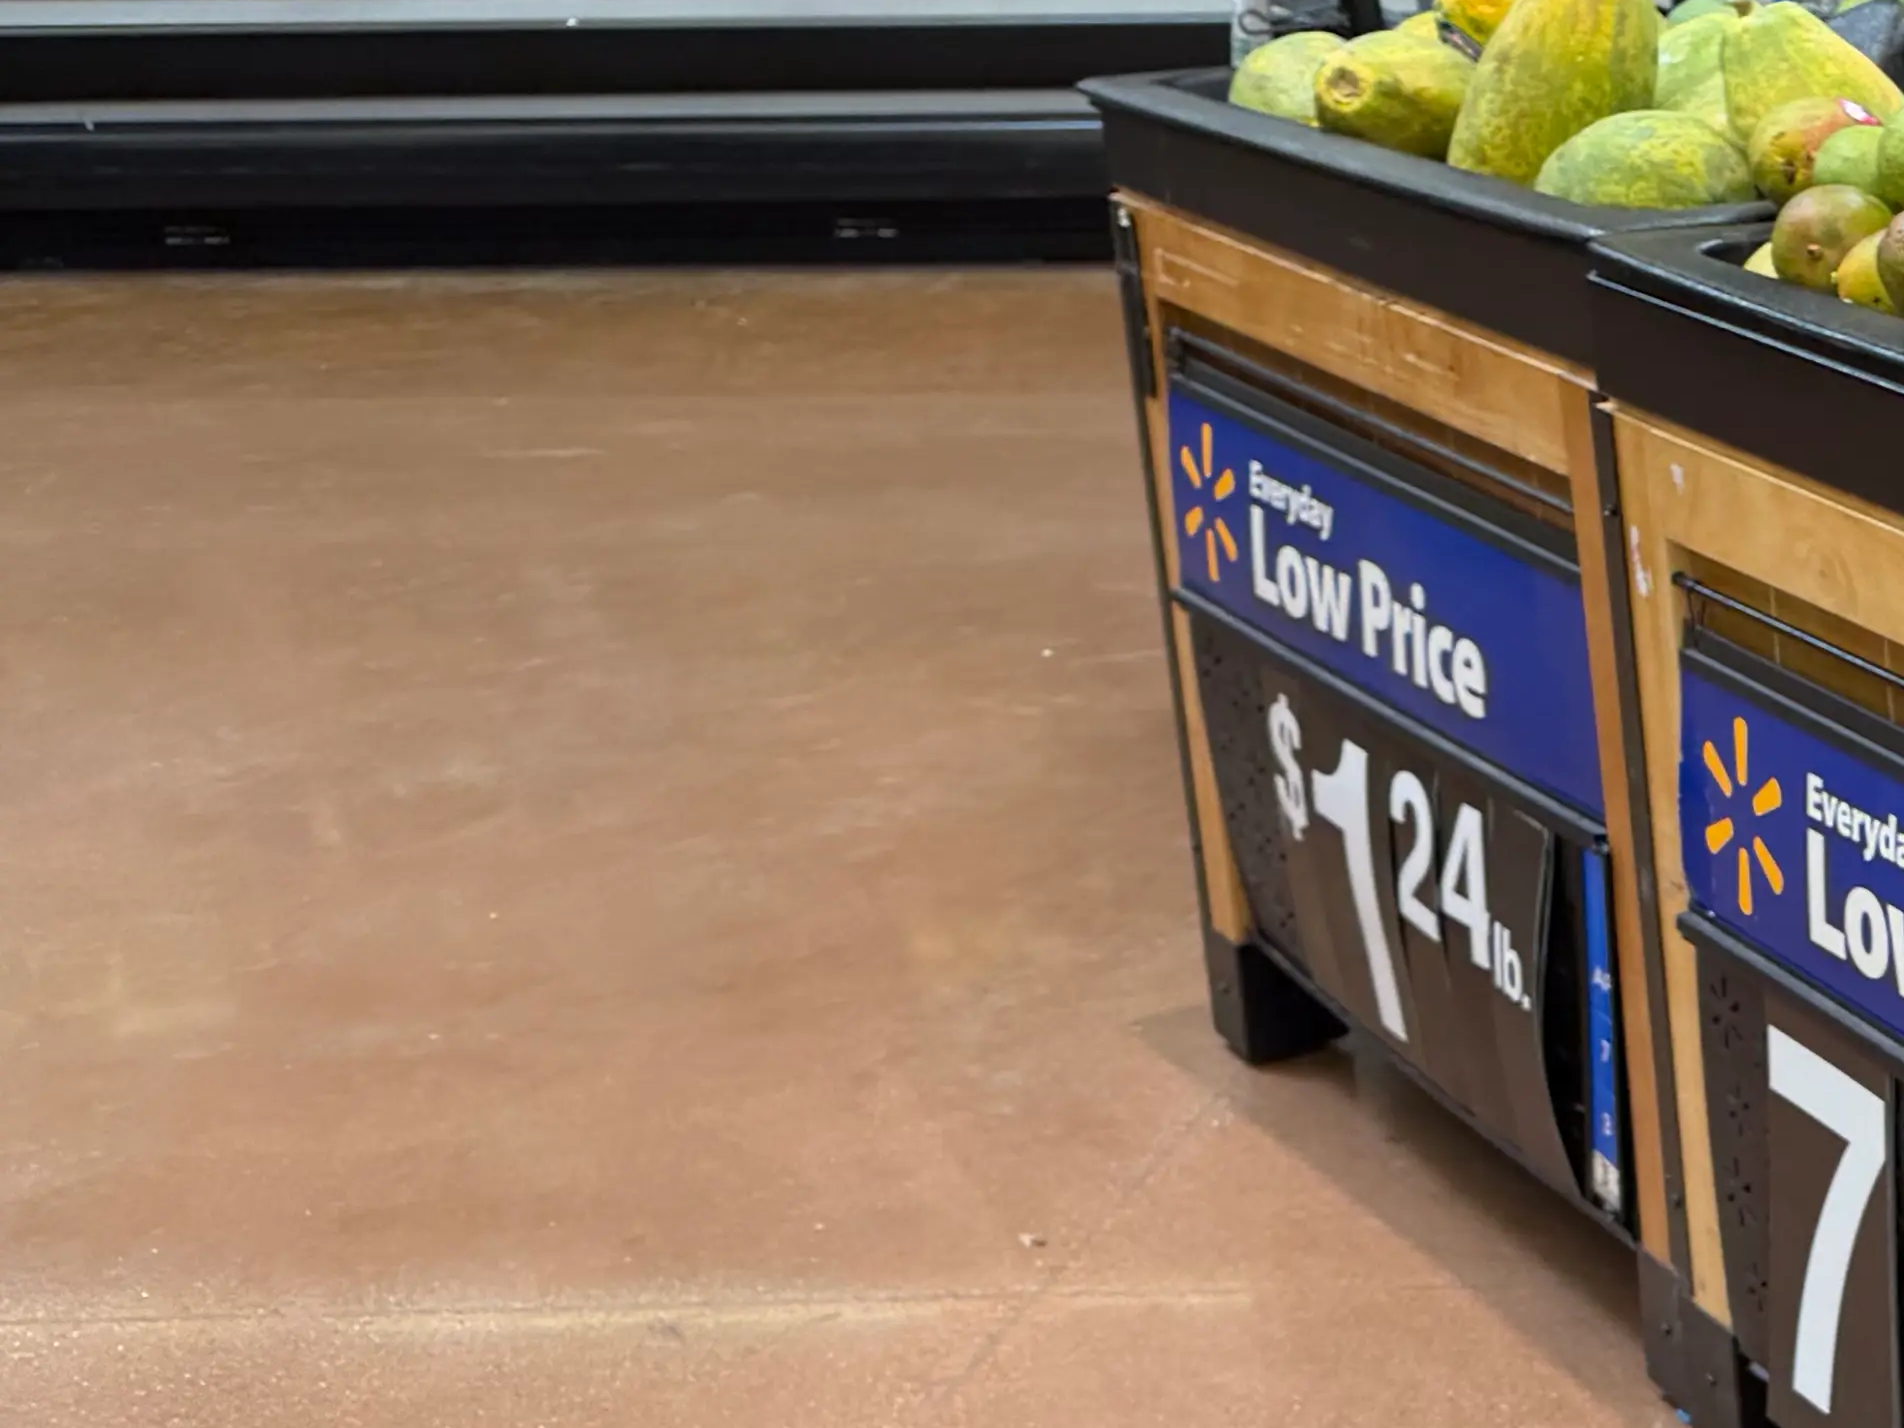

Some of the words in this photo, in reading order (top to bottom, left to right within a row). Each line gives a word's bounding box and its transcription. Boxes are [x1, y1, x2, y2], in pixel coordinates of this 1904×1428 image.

[1249, 460, 1333, 541] Everyday
[1250, 504, 1351, 641] Low
[1358, 558, 1486, 719] Price
